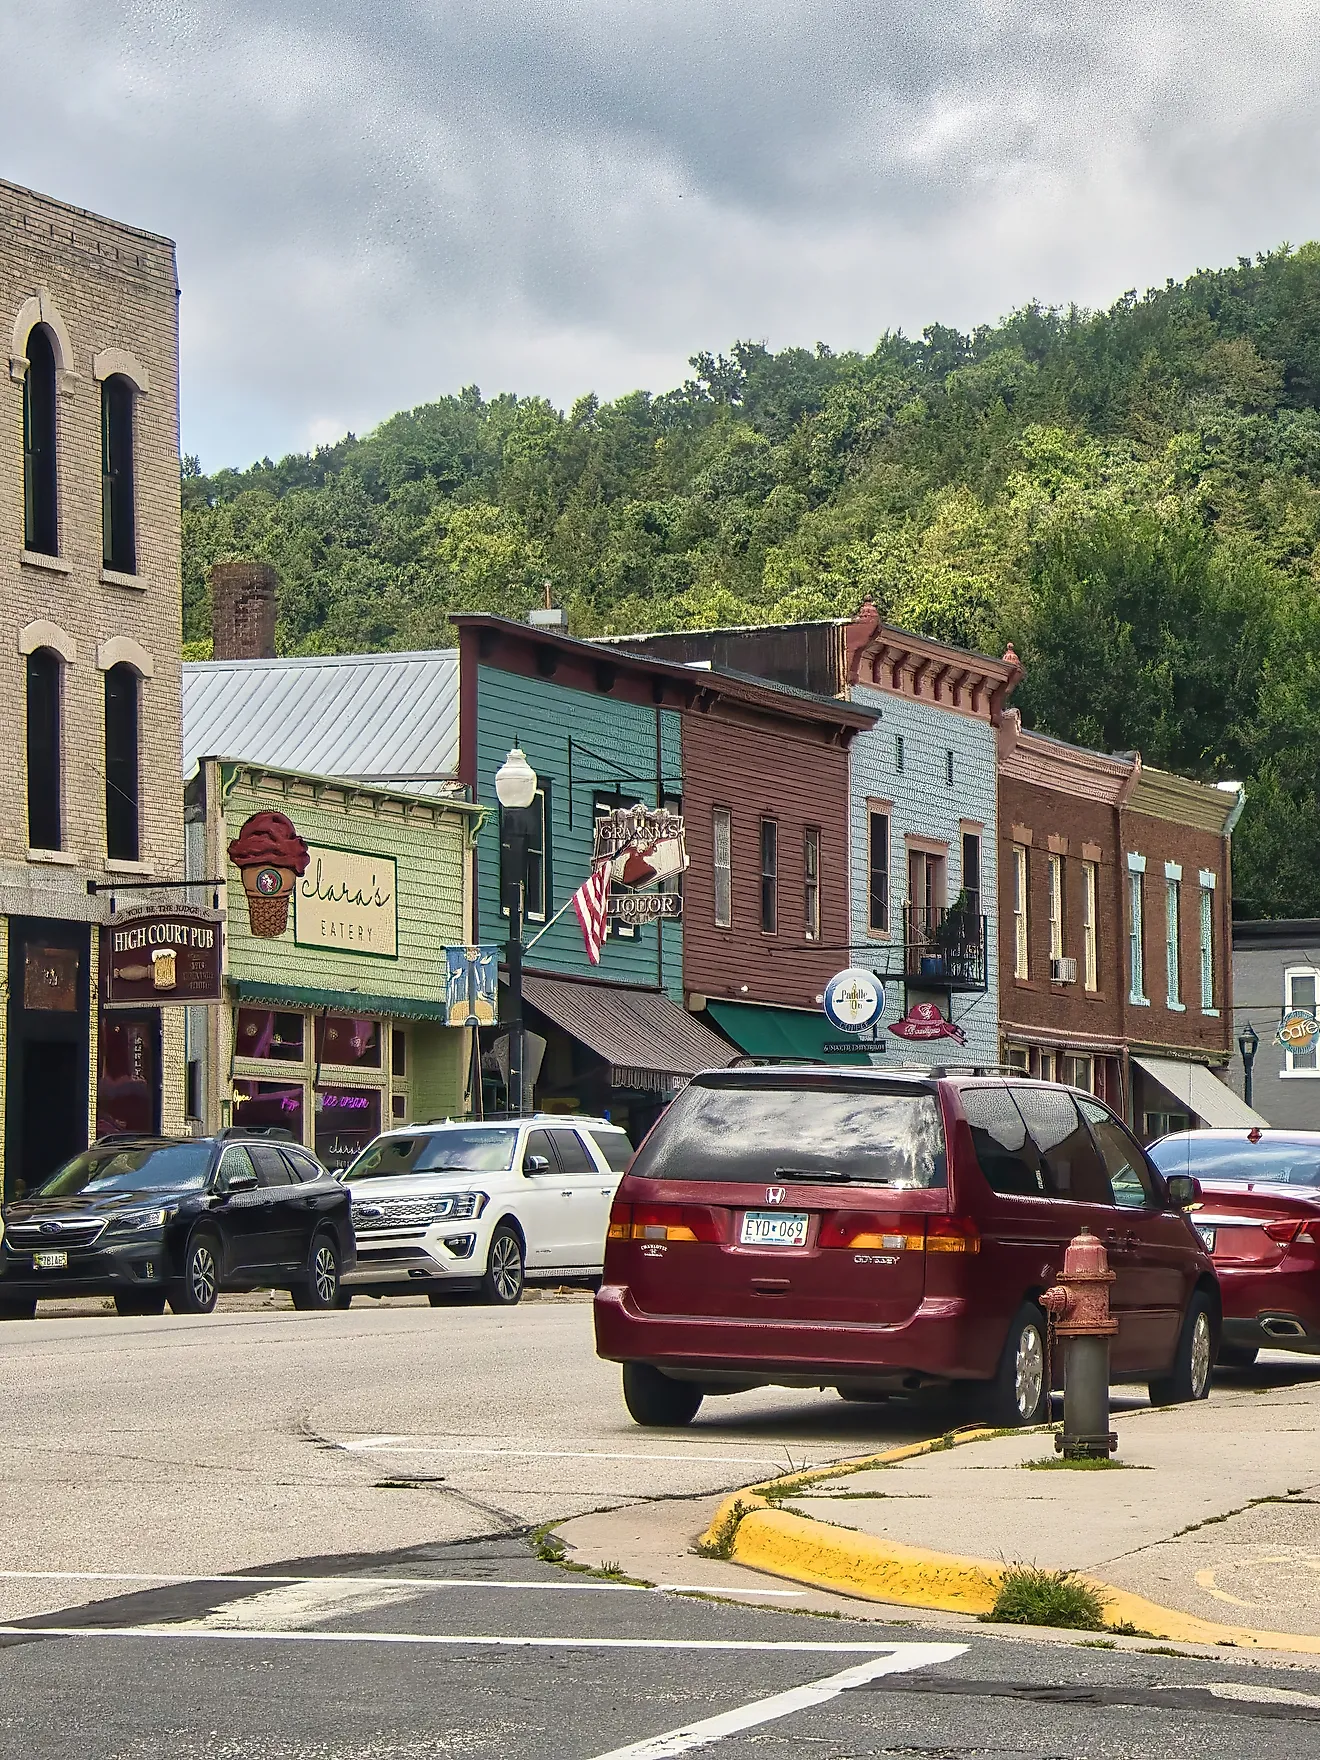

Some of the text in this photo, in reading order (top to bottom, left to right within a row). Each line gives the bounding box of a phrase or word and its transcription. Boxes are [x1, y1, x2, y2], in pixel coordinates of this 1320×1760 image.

[301, 858, 391, 908] clara's
[146, 905, 156, 913] BE
[159, 904, 173, 912] THE
[606, 897, 673, 916] LIQUOR
[114, 923, 214, 952] HIGH COURT PUB
[321, 920, 373, 943] EATERY
[841, 988, 867, 1001] Paddle
[746, 1219, 803, 1238] EYD 069
